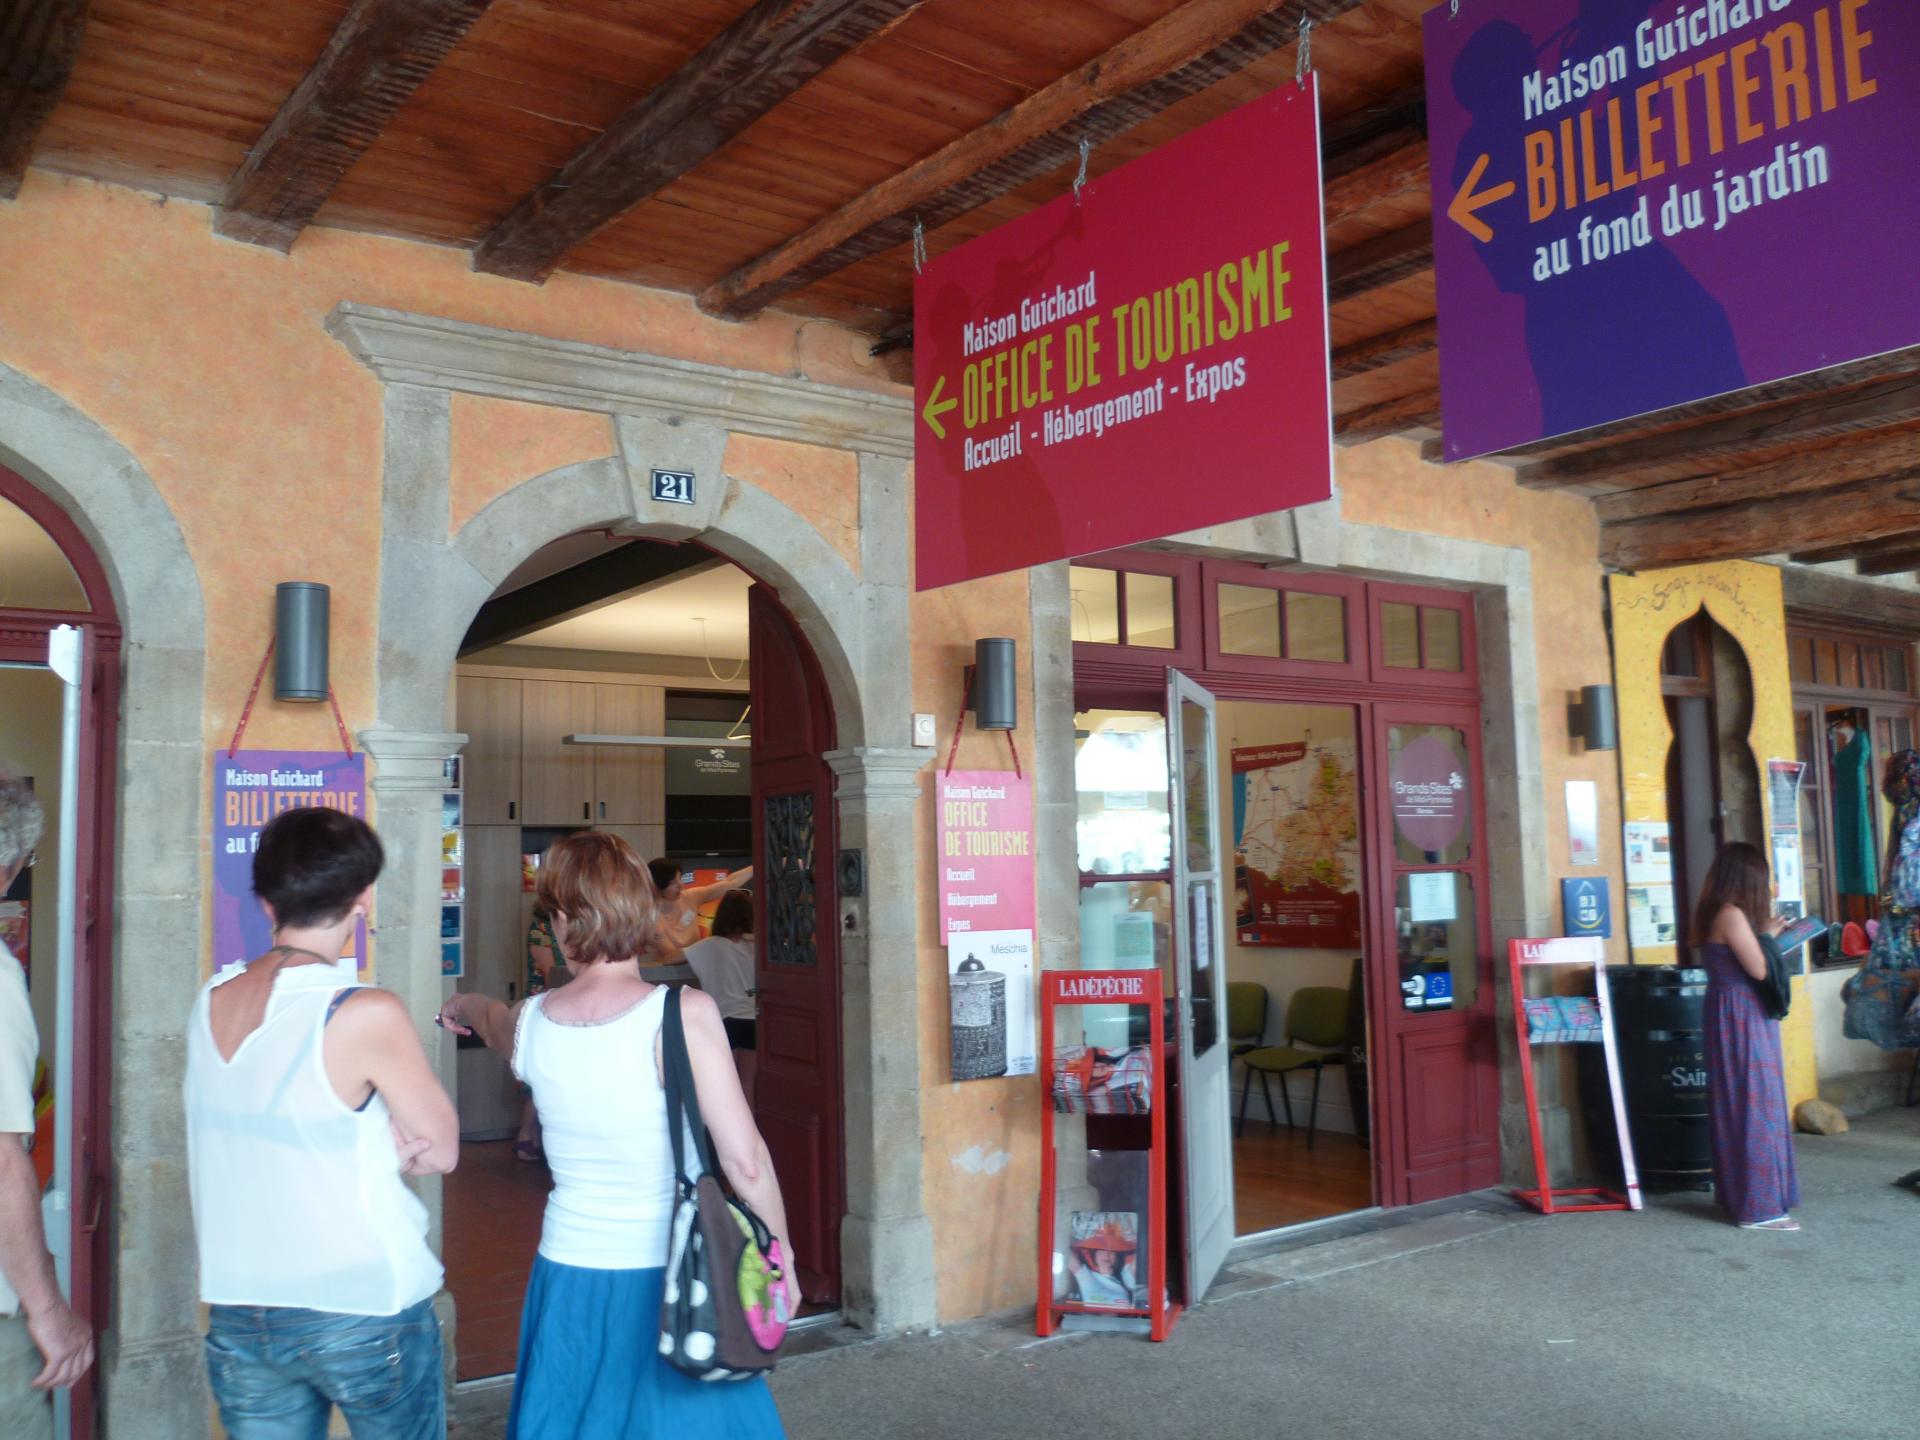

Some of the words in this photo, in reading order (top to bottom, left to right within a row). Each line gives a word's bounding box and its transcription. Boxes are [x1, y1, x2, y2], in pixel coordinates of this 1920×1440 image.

[1522, 44, 1627, 121] Maison
[1635, 0, 1791, 69] Guichar
[1524, 0, 1878, 224] BILLETTERIE
[1532, 238, 1571, 282] au
[1577, 196, 1652, 266] fond
[1660, 184, 1705, 237] du
[1713, 141, 1829, 231] jardin
[963, 313, 1017, 357] Maison
[1021, 270, 1096, 333] Guichard
[963, 334, 1053, 429] OFFICE
[1065, 315, 1101, 394] DE
[1112, 240, 1292, 377] TOURISME
[964, 421, 1022, 471] Accueil
[1043, 377, 1164, 447] Hébergement
[1185, 357, 1246, 403] Expos
[660, 474, 689, 500] 21
[225, 769, 269, 786] Maison
[270, 769, 323, 787] Guichard
[944, 801, 988, 827] OFFICE
[226, 837, 247, 854] au
[945, 831, 961, 857] DE
[965, 831, 1029, 857] TOURISME
